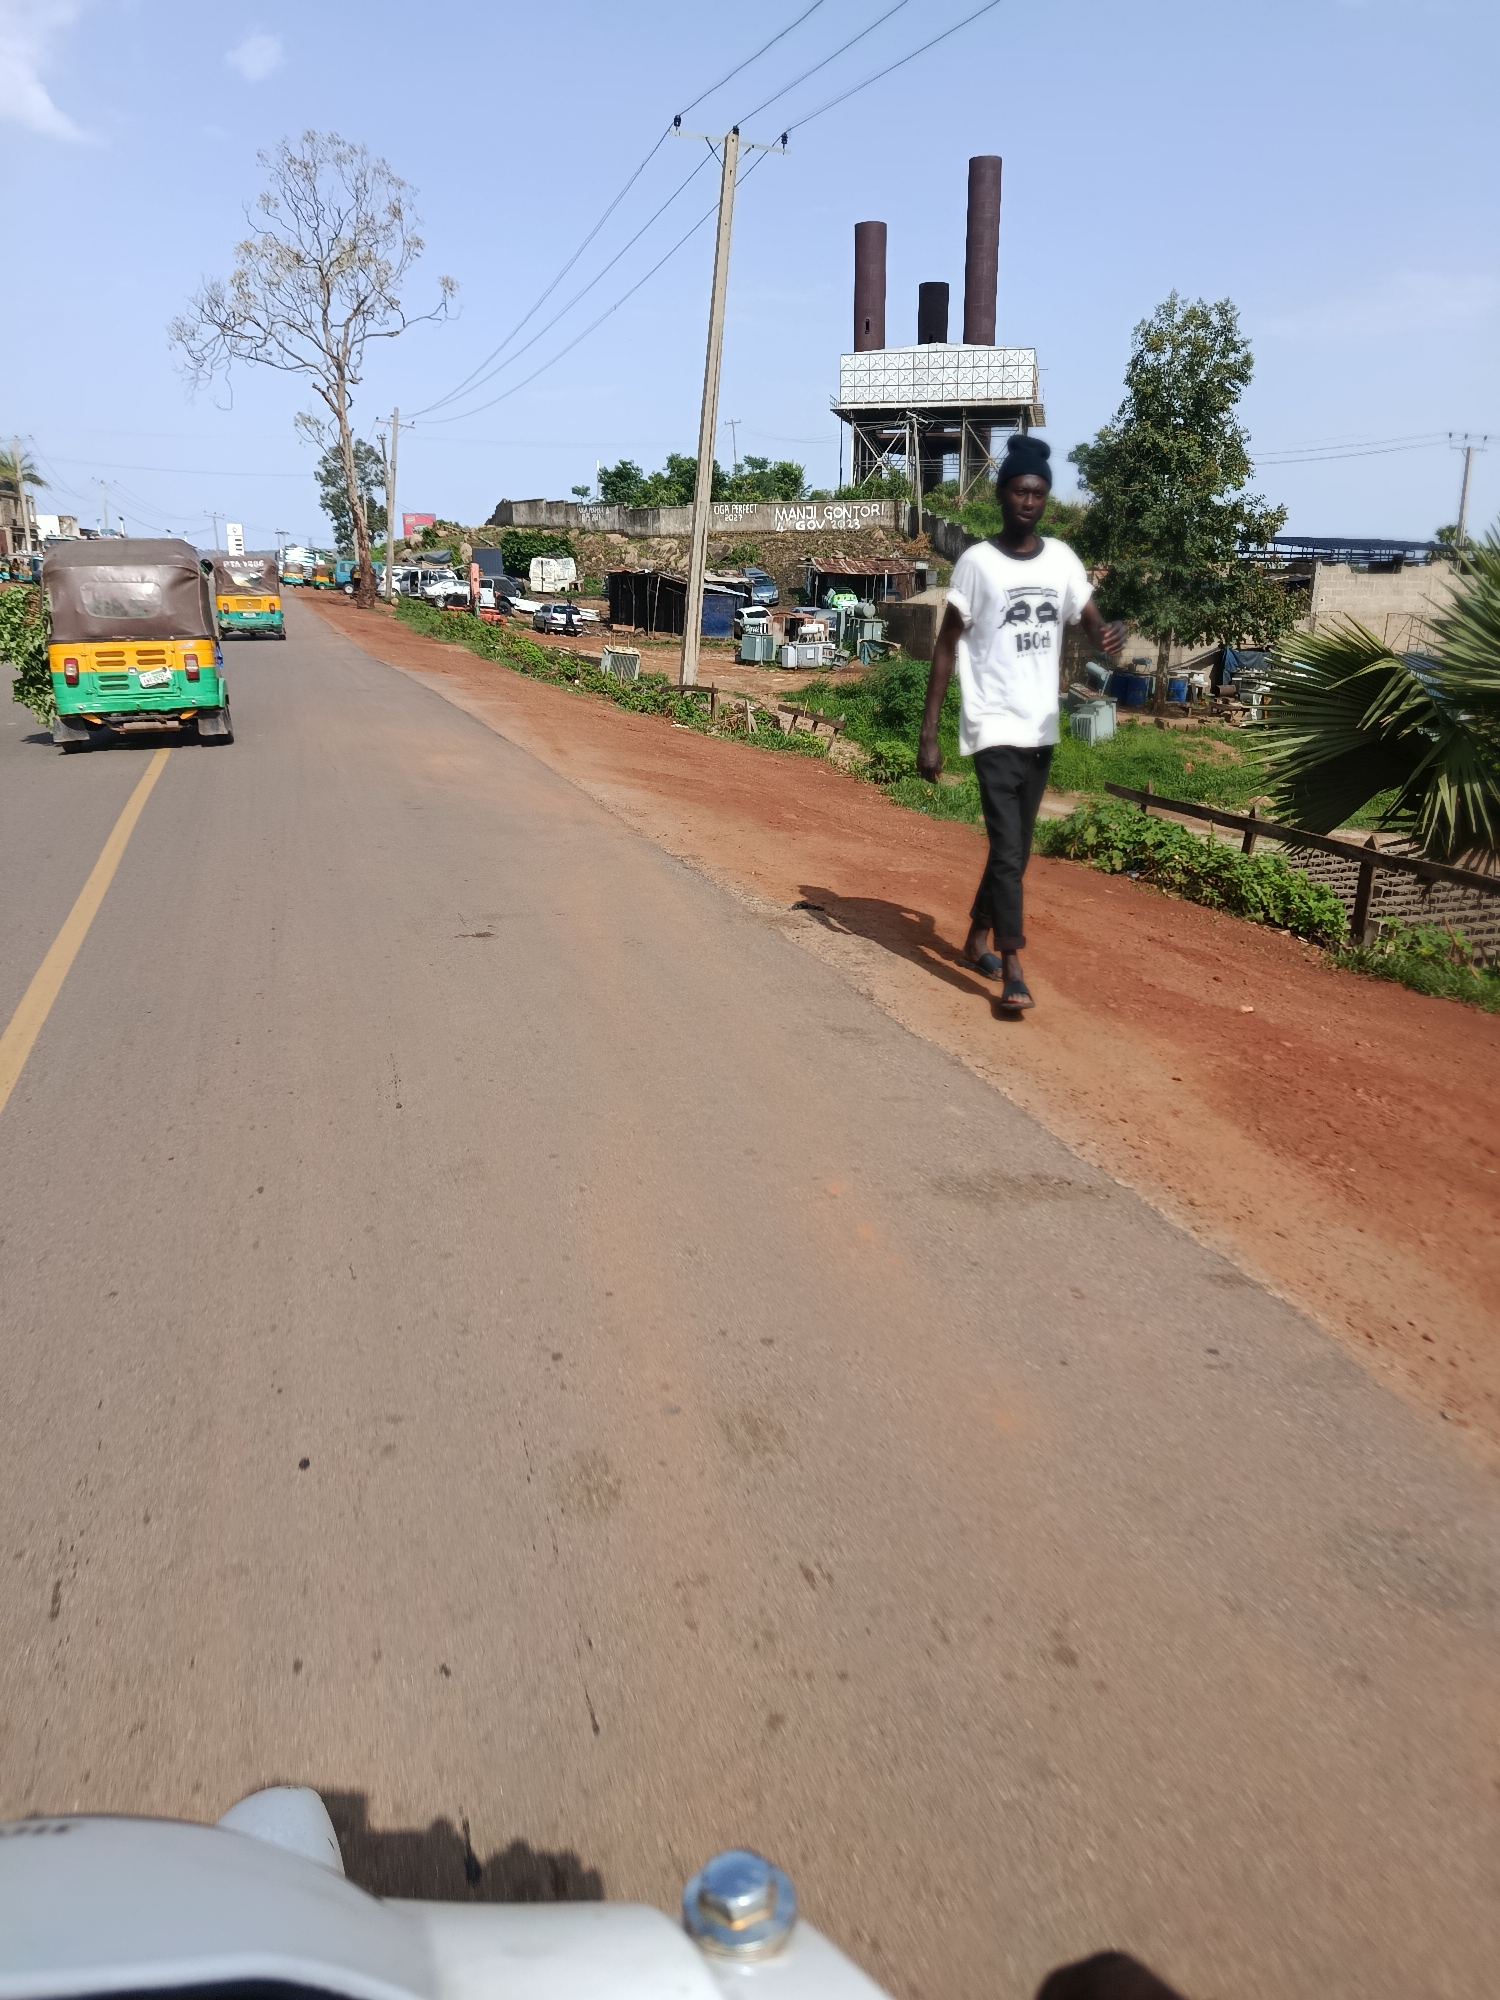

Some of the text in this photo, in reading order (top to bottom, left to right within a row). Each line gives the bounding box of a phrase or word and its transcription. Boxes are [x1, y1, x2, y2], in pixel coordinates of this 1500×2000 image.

[713, 503, 758, 515] OGA PERFECT
[775, 503, 884, 522] MANJI GONTORI
[725, 514, 743, 522] 2027
[795, 519, 826, 531] GOV
[830, 519, 861, 531] 2023
